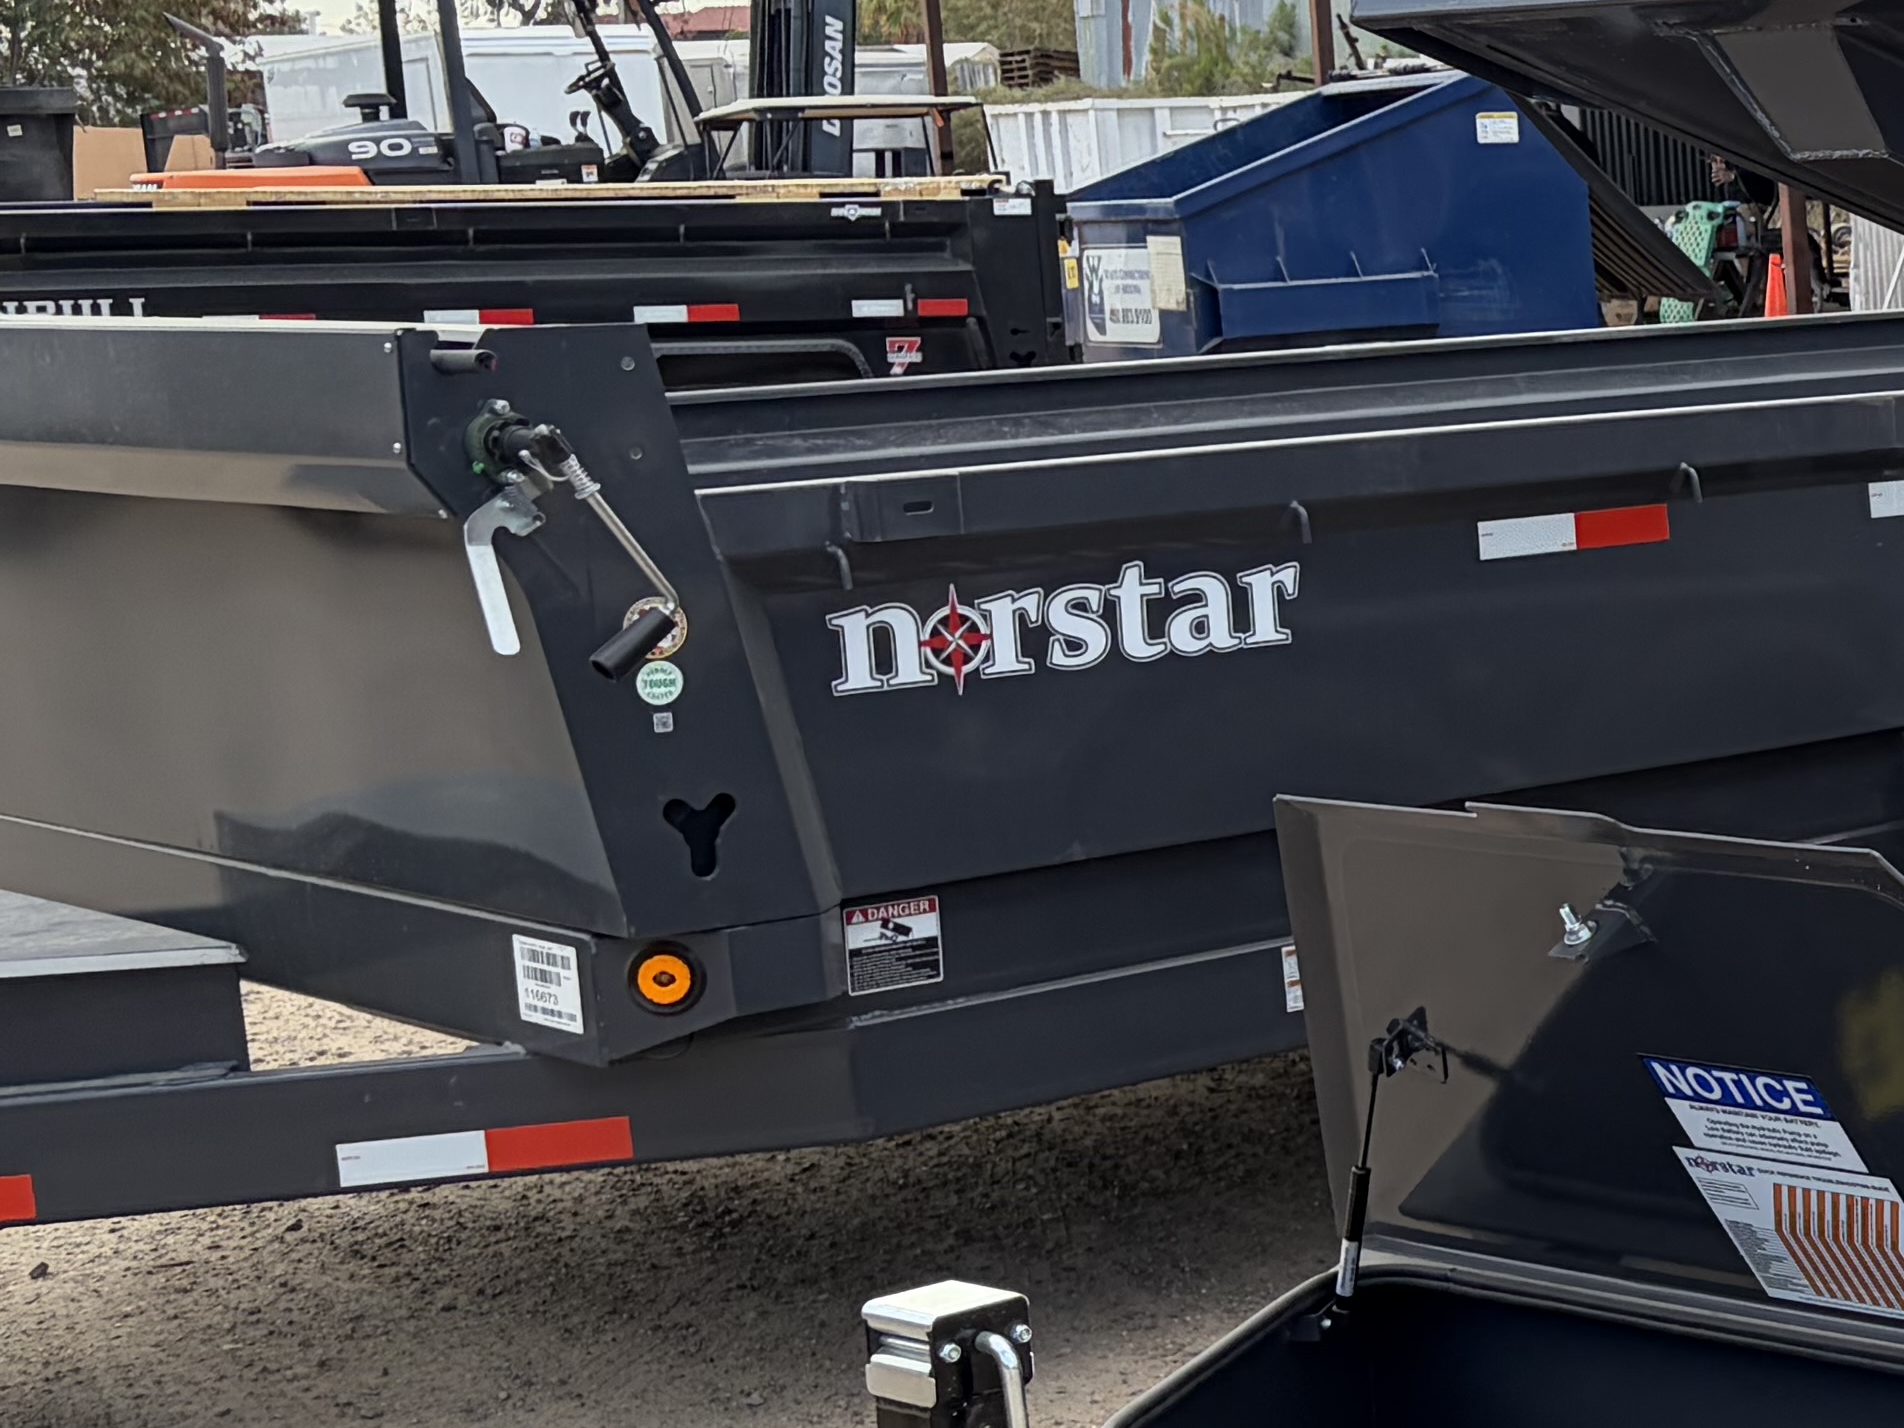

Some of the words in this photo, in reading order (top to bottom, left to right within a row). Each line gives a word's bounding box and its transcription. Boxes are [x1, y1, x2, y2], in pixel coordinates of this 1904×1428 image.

[822, 14, 843, 137] DOSAN
[348, 138, 411, 160] 90
[827, 560, 1301, 696] norstar
[867, 900, 930, 921] DANGER
[1651, 1061, 1823, 1115] NOTICE
